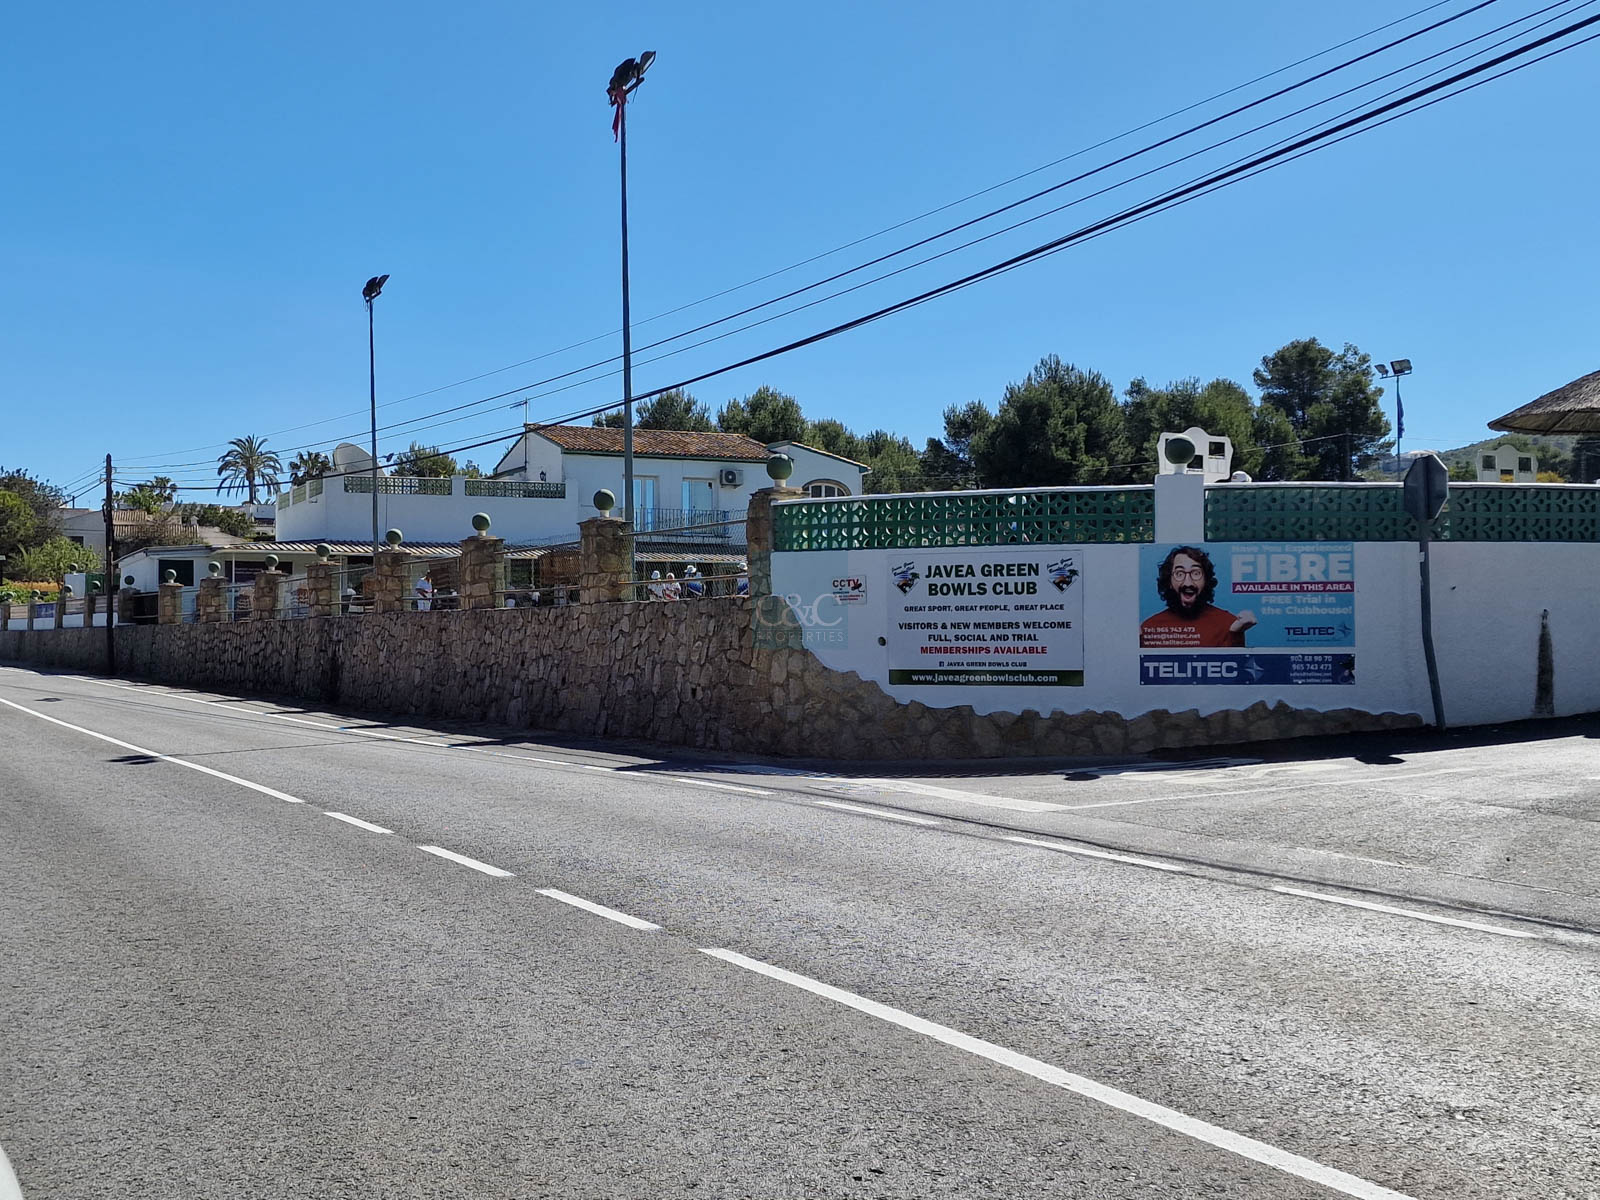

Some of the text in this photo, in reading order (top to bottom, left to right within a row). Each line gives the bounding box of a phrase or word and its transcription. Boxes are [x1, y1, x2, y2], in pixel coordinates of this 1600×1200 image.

[925, 565, 975, 578] JAVEA
[981, 563, 1039, 577] GREEN
[1232, 554, 1352, 582] FIBRE
[833, 579, 859, 587] CCTV
[928, 582, 1038, 596] BOWLS CLUB
[1262, 595, 1336, 604] FREE Trial in
[1262, 606, 1352, 614] the Clubhouse!
[1285, 627, 1335, 635] TELITEC
[1144, 662, 1238, 678] TELITEC
[912, 672, 1058, 683] www.javeagreenbowlsclub.com
